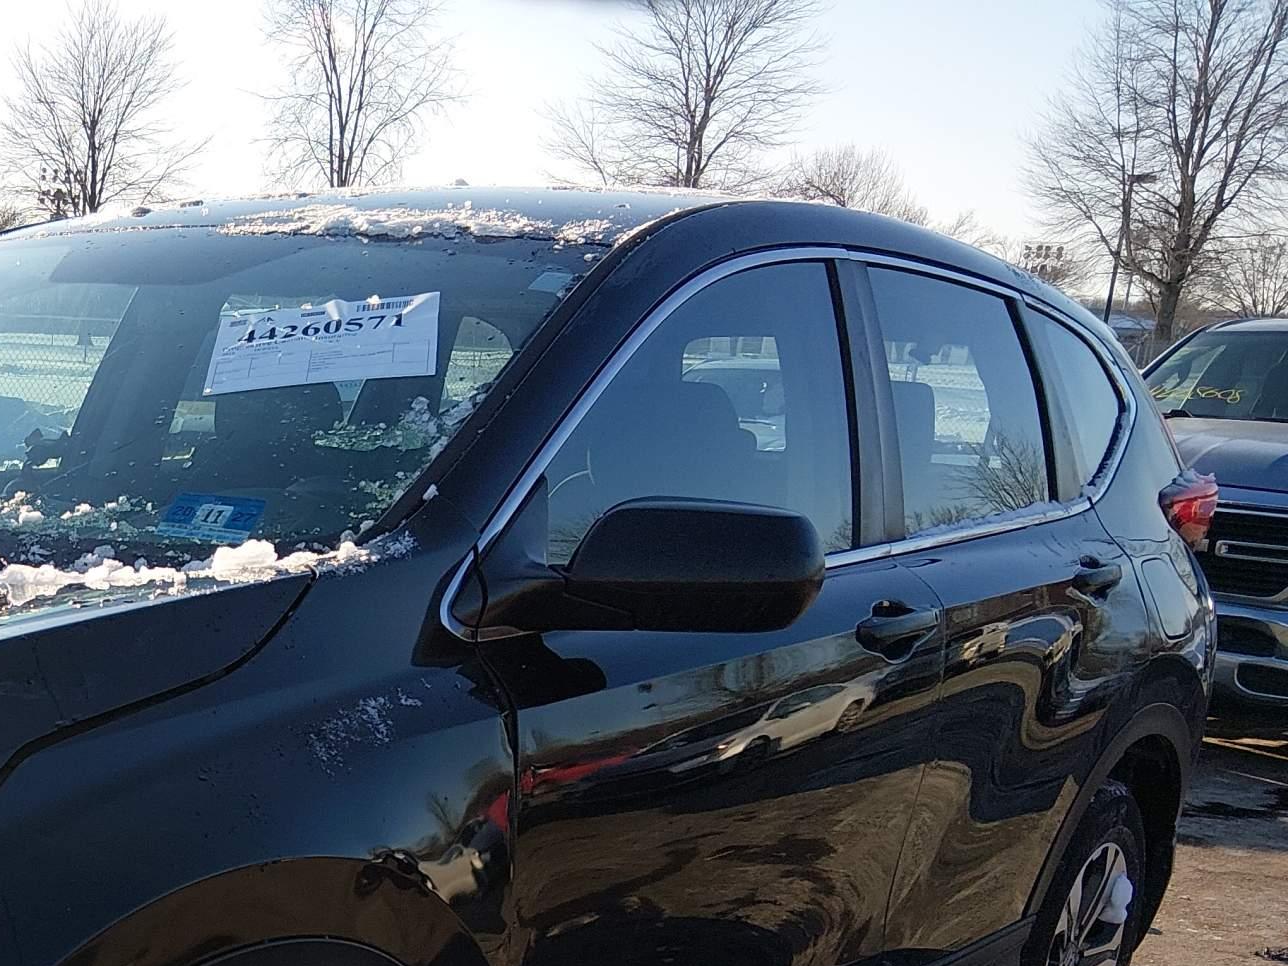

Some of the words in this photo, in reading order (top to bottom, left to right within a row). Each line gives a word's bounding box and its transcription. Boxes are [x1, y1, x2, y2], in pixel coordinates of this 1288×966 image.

[237, 312, 405, 343] 44260571
[200, 508, 225, 523] 11
[232, 511, 256, 522] 27
